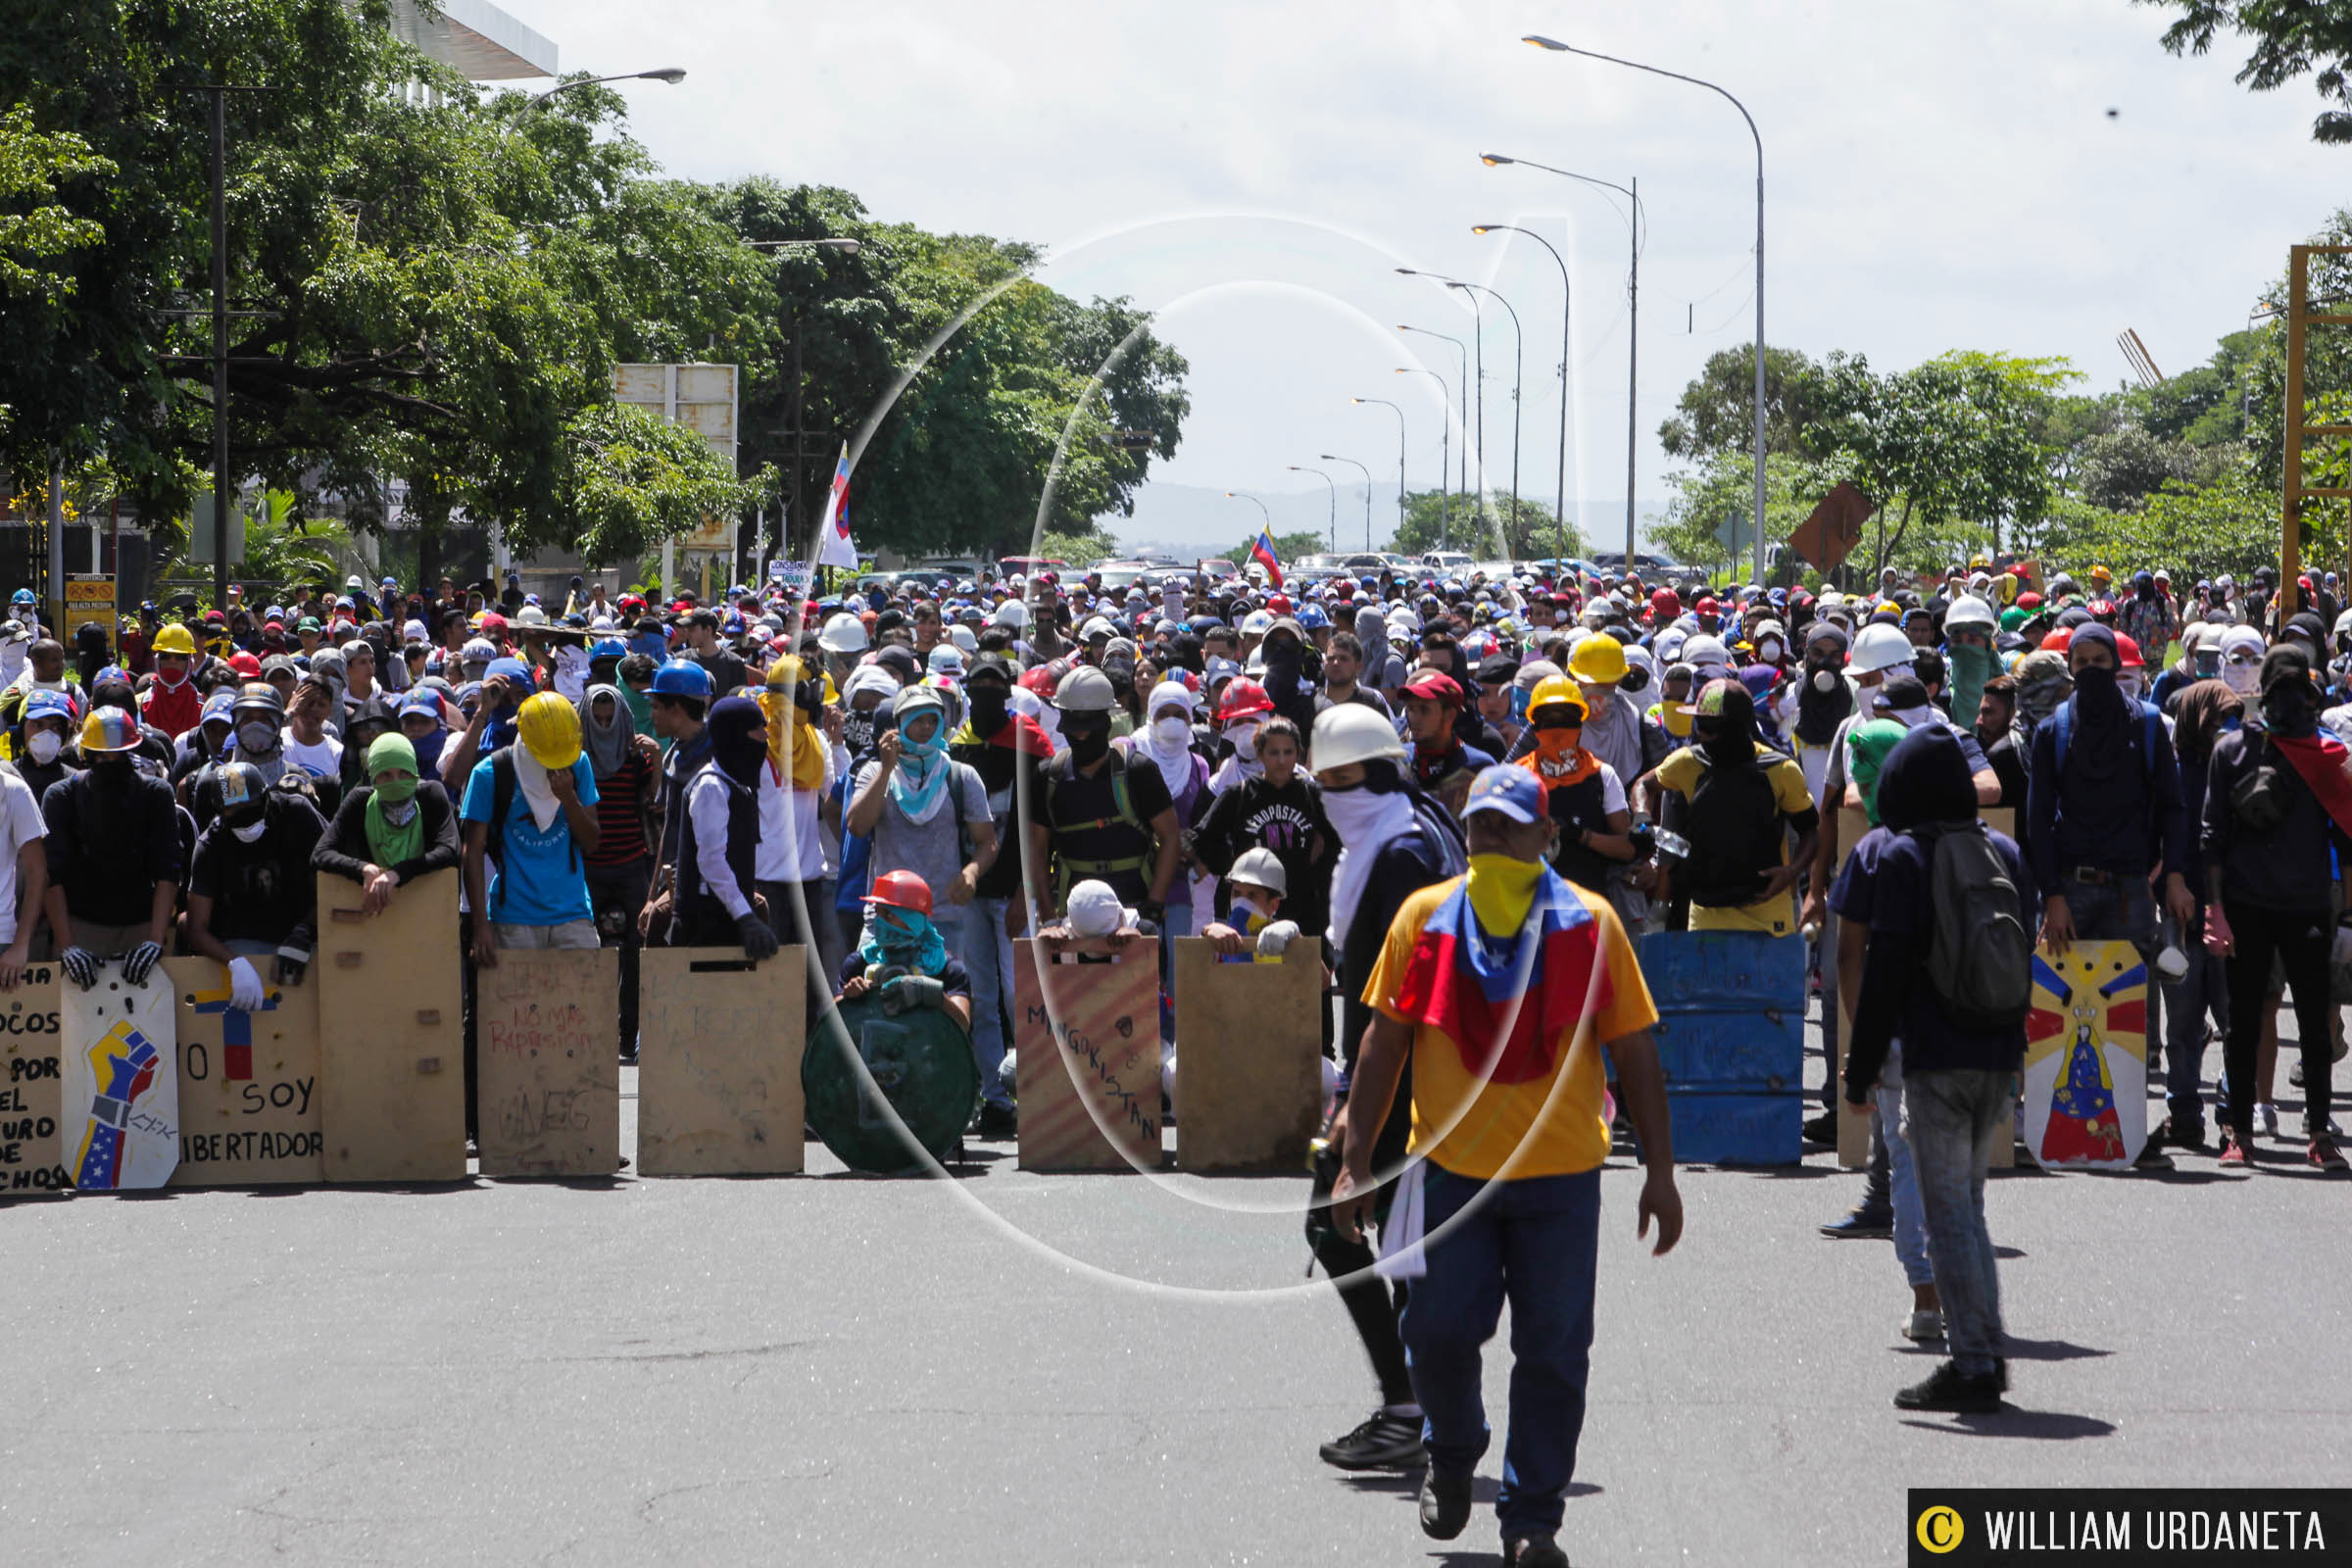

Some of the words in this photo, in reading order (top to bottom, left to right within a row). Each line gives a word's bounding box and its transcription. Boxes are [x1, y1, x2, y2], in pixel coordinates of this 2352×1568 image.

[1245, 804, 1312, 835] AEROPOSTALE
[1265, 822, 1295, 848] NY
[12, 1056, 61, 1084] POR
[242, 1076, 315, 1115] SOY
[0, 1117, 56, 1141] URO
[178, 1131, 323, 1164] IBERTADOR
